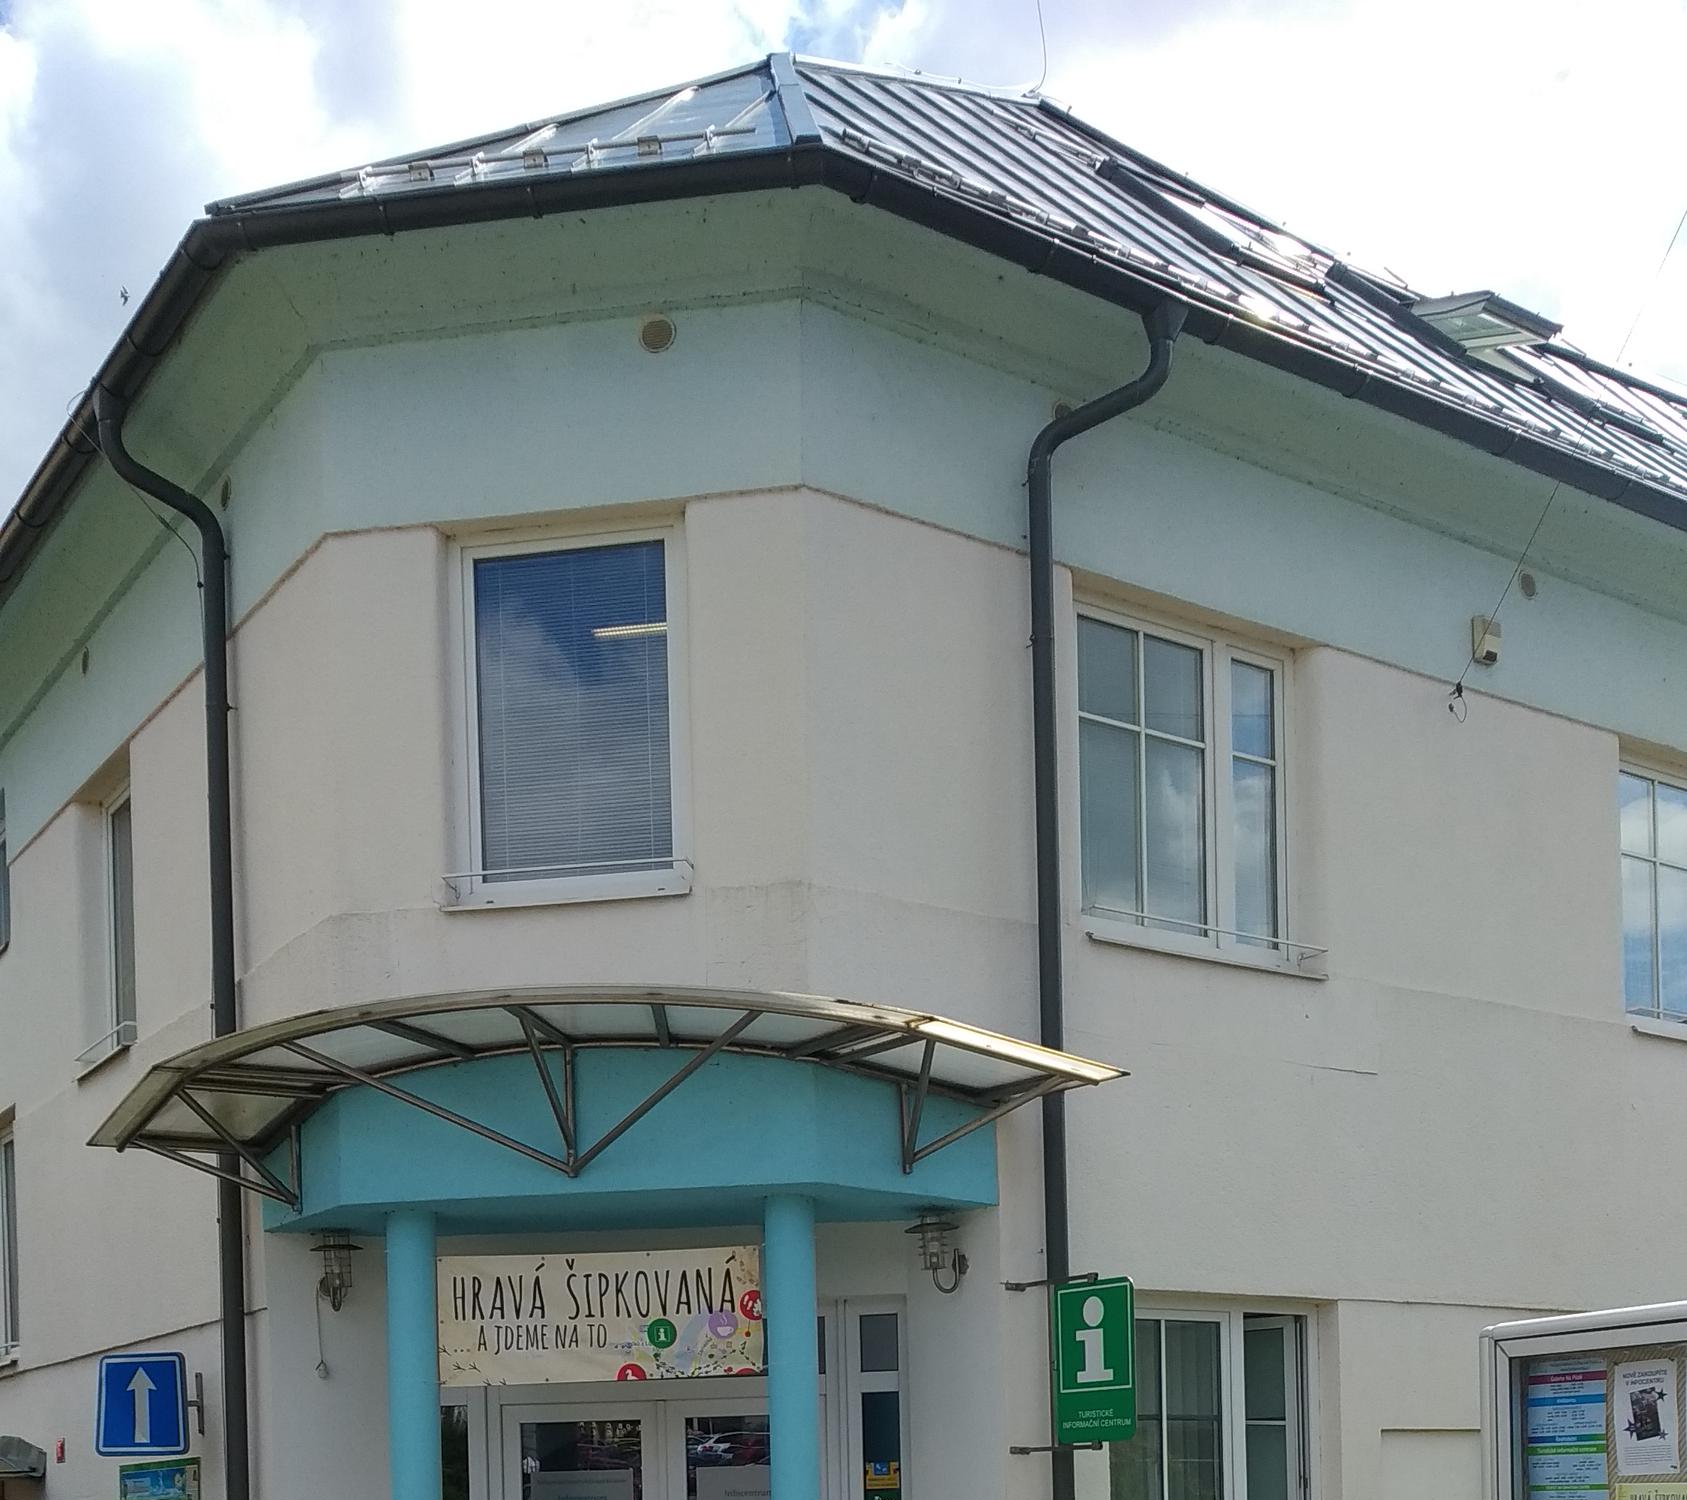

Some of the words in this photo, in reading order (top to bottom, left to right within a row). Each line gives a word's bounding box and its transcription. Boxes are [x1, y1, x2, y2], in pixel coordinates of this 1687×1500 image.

[453, 1263, 545, 1320] HRAVÁ
[565, 1256, 736, 1320] ŠIPKOVANÁ
[477, 1325, 488, 1351] A
[494, 1324, 549, 1355] JDEME
[555, 1324, 579, 1349] NA
[587, 1323, 608, 1348] TO
[1062, 1419, 1099, 1429] INFORMAČNÍ
[1101, 1418, 1131, 1427] CENTRUM
[1078, 1408, 1114, 1418] TURISTICKÉ
